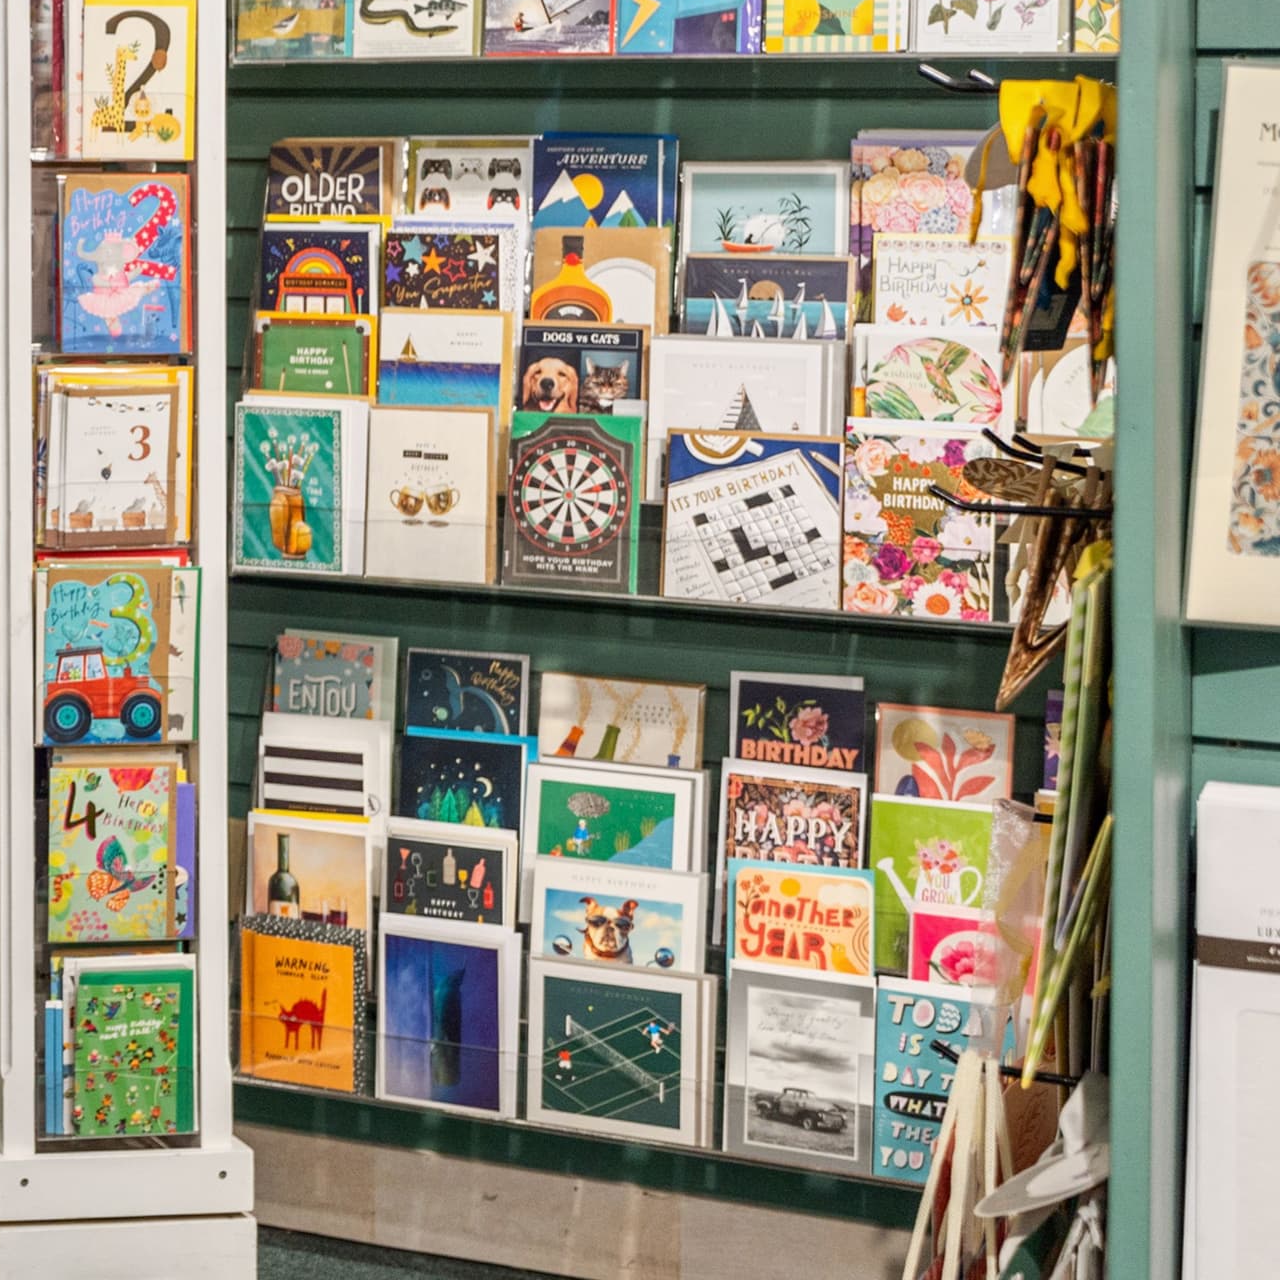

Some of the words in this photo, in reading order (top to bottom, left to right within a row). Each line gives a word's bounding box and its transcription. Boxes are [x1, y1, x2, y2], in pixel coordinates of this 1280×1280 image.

[556, 152, 648, 166] ADVENTURE
[281, 172, 365, 205] OLDER
[124, 183, 178, 281] 2
[888, 256, 939, 278] HAPPY
[423, 270, 494, 298] Superstar
[879, 275, 949, 298] BIRTHDAY
[542, 332, 573, 344] DOGS
[577, 334, 588, 344] vs
[591, 333, 621, 345] CATS
[289, 355, 335, 366] BIRTHDAY
[296, 347, 328, 357] HAPPY
[128, 424, 151, 461] 3
[695, 482, 724, 506] YOUR
[727, 461, 801, 496] BIRTHDAY!
[892, 476, 937, 492] HAPPY
[882, 493, 946, 511] BIRTHDAY
[102, 573, 153, 665] 3
[288, 672, 358, 719] ENJOY
[741, 738, 860, 770] BIRTHDAY
[63, 781, 105, 842] 4
[733, 807, 852, 853] HAPPY
[429, 898, 458, 908] HAPPY
[919, 888, 957, 905] GROW
[423, 907, 465, 920] BIRTHDAY
[275, 957, 330, 974] WARNING
[898, 1032, 924, 1056] IS
[882, 1062, 932, 1088] DAY
[891, 1121, 934, 1145] THE
[879, 1146, 924, 1169] YOU
